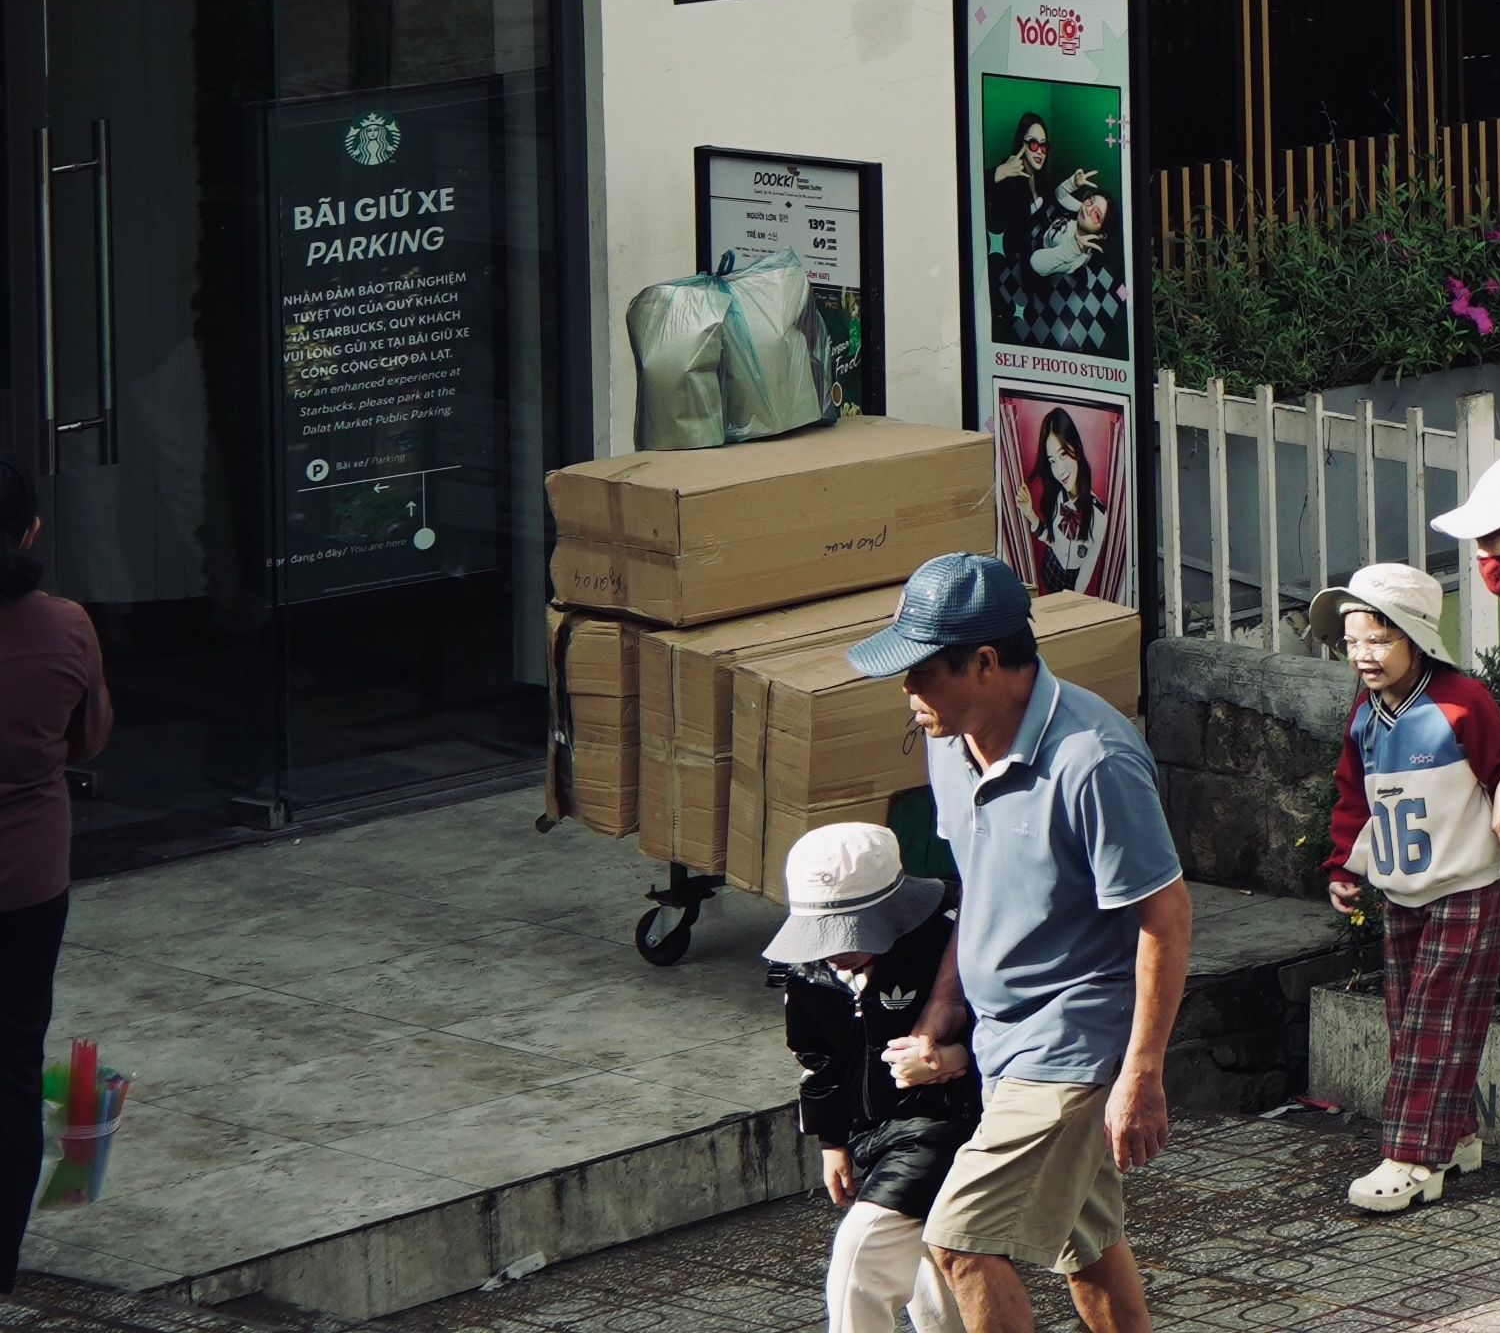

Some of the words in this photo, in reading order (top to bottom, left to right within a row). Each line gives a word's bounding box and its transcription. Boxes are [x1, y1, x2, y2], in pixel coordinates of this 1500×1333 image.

[1040, 4, 1068, 18] Photo
[753, 172, 795, 189] DOOKKI
[293, 197, 346, 231] BÃI
[354, 188, 411, 222] GIỮ
[417, 187, 455, 215] XE
[808, 218, 825, 230] 139
[306, 226, 445, 266] PARKING
[813, 237, 826, 249] 69
[326, 285, 355, 301] ĐẢM
[358, 280, 385, 296] BẢO
[417, 271, 467, 288] NGHIỆM
[293, 307, 331, 324] TUYỆT
[358, 299, 384, 315] CỦA
[415, 291, 458, 308] KHÁCH
[312, 320, 387, 340] STARBUCKS,
[418, 309, 461, 325] KHÁCH
[283, 350, 304, 363] VUI
[369, 339, 385, 350] XE
[387, 337, 405, 350] TẠI
[455, 327, 471, 338] XE
[380, 354, 409, 368] CHỢ
[410, 352, 428, 364] ĐÀ
[994, 351, 1029, 370] SELF
[1031, 355, 1077, 376] PHOTO
[1079, 363, 1128, 384] STUDIO
[293, 387, 312, 400] For
[313, 387, 328, 397] an
[330, 377, 385, 393] enhanced
[387, 370, 448, 386] experience
[449, 367, 461, 377] at
[299, 401, 357, 418] Starbucks,
[358, 396, 394, 411] please
[396, 389, 422, 405] park
[423, 389, 435, 400] at
[436, 386, 456, 397] the
[302, 423, 331, 436] Dalat
[333, 417, 373, 432] Market
[375, 412, 409, 425] Public
[410, 405, 454, 421] Parking.
